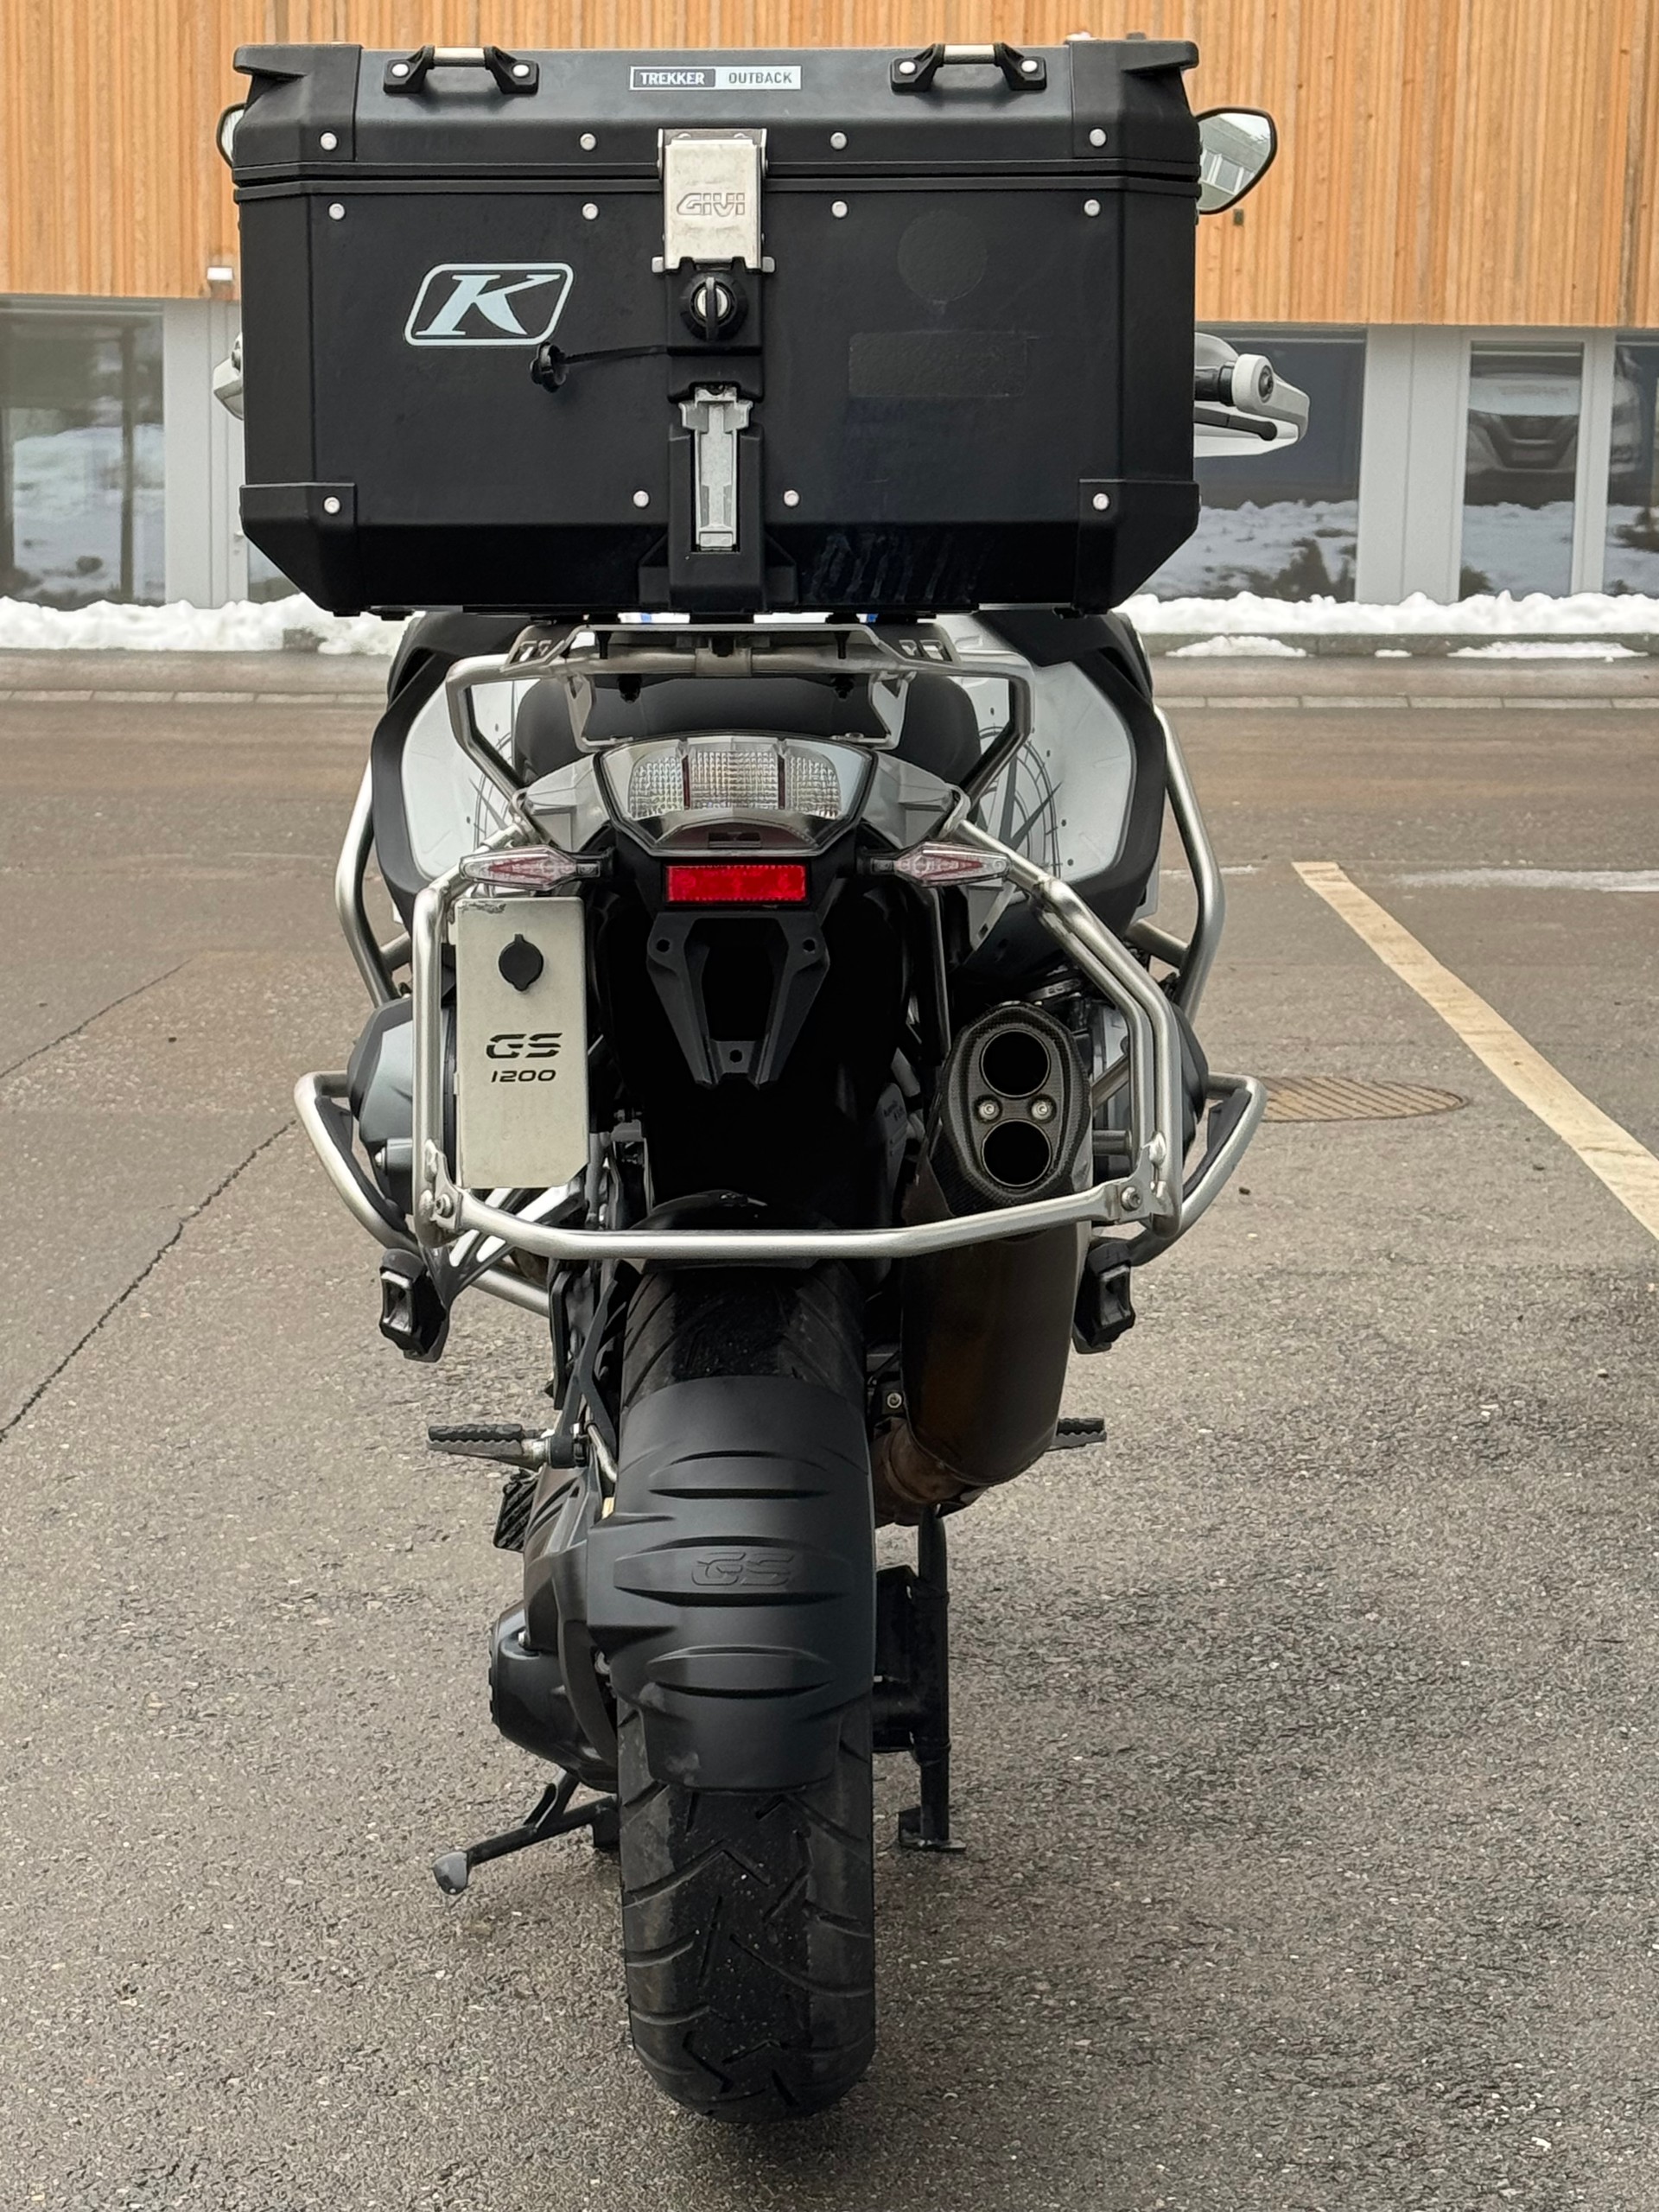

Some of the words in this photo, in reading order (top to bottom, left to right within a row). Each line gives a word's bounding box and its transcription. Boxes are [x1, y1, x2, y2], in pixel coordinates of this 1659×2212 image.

[640, 72, 705, 85] TREKKER
[728, 72, 792, 84] OUTBACK
[677, 193, 745, 217] GIVI
[415, 274, 561, 335] K
[486, 1033, 563, 1058] GS
[491, 1070, 556, 1083] 1200
[691, 1552, 794, 1586] GS
